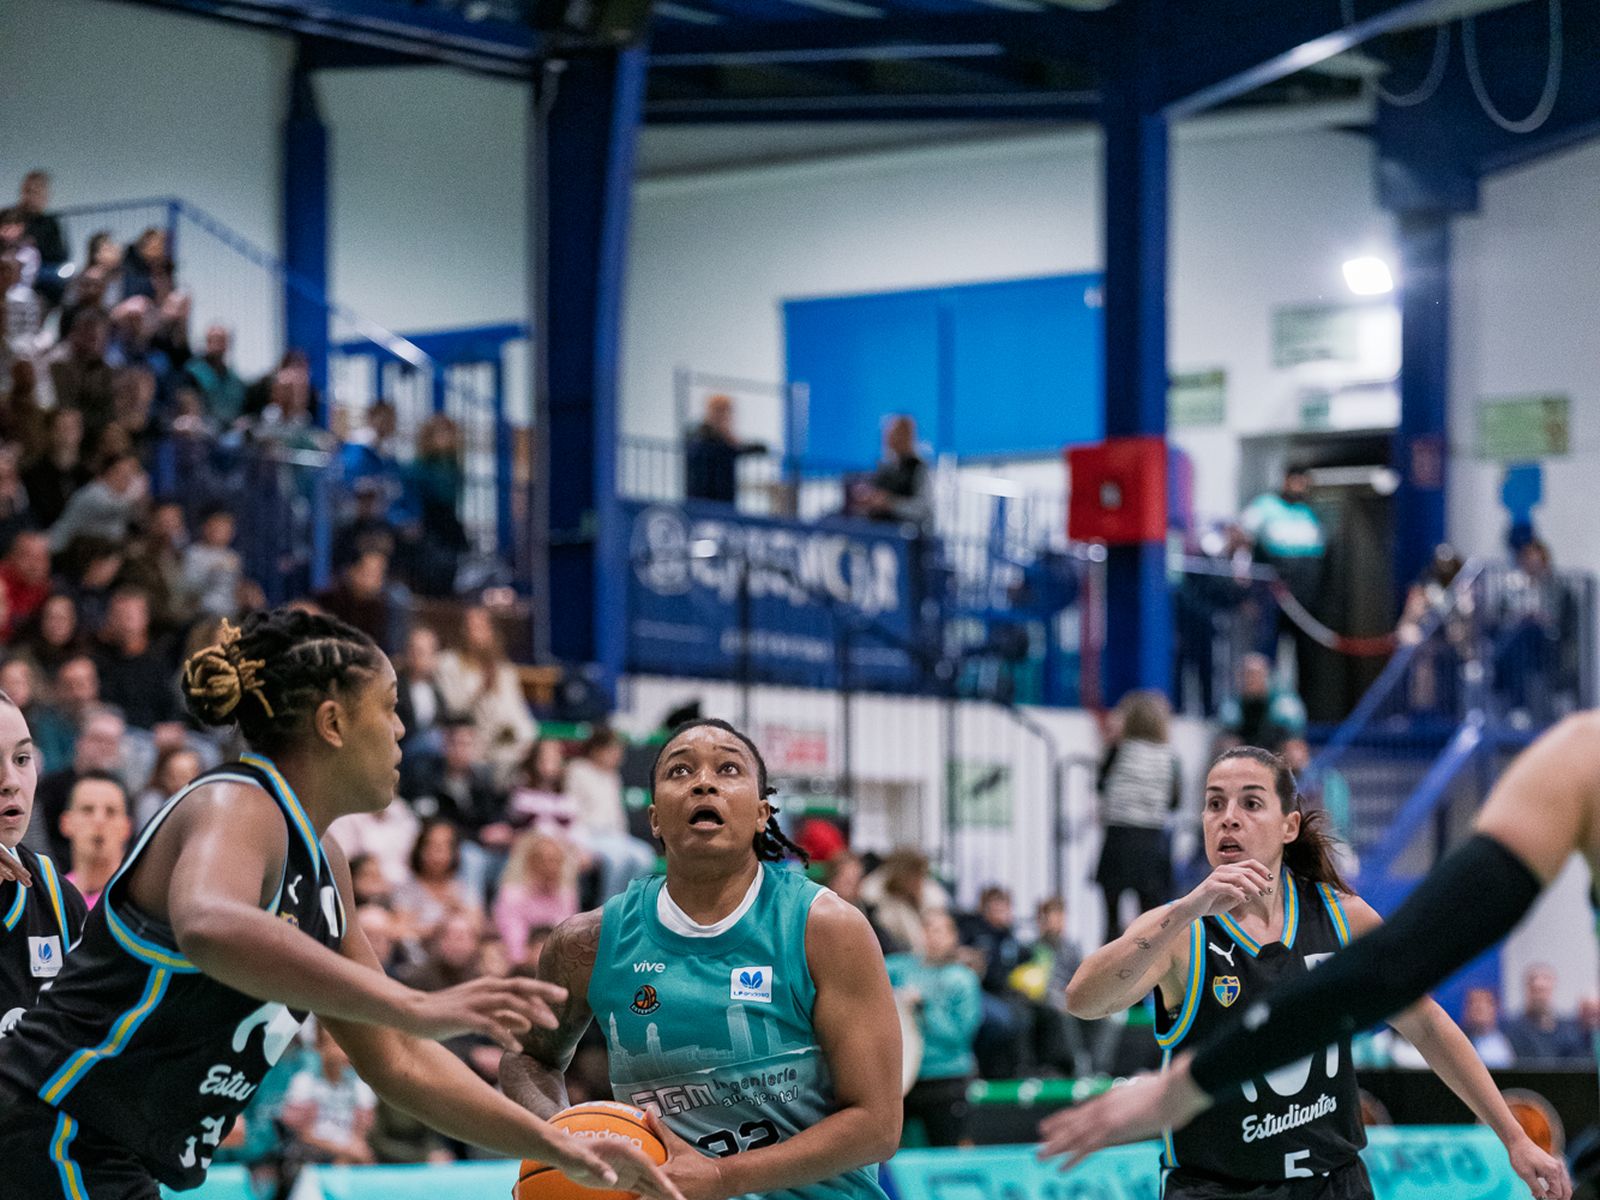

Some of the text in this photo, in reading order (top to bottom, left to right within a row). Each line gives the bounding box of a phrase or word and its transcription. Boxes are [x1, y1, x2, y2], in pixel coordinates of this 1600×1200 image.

[633, 960, 666, 973] vive
[199, 1064, 258, 1101] Estu
[1241, 1093, 1338, 1144] Estudiantes
